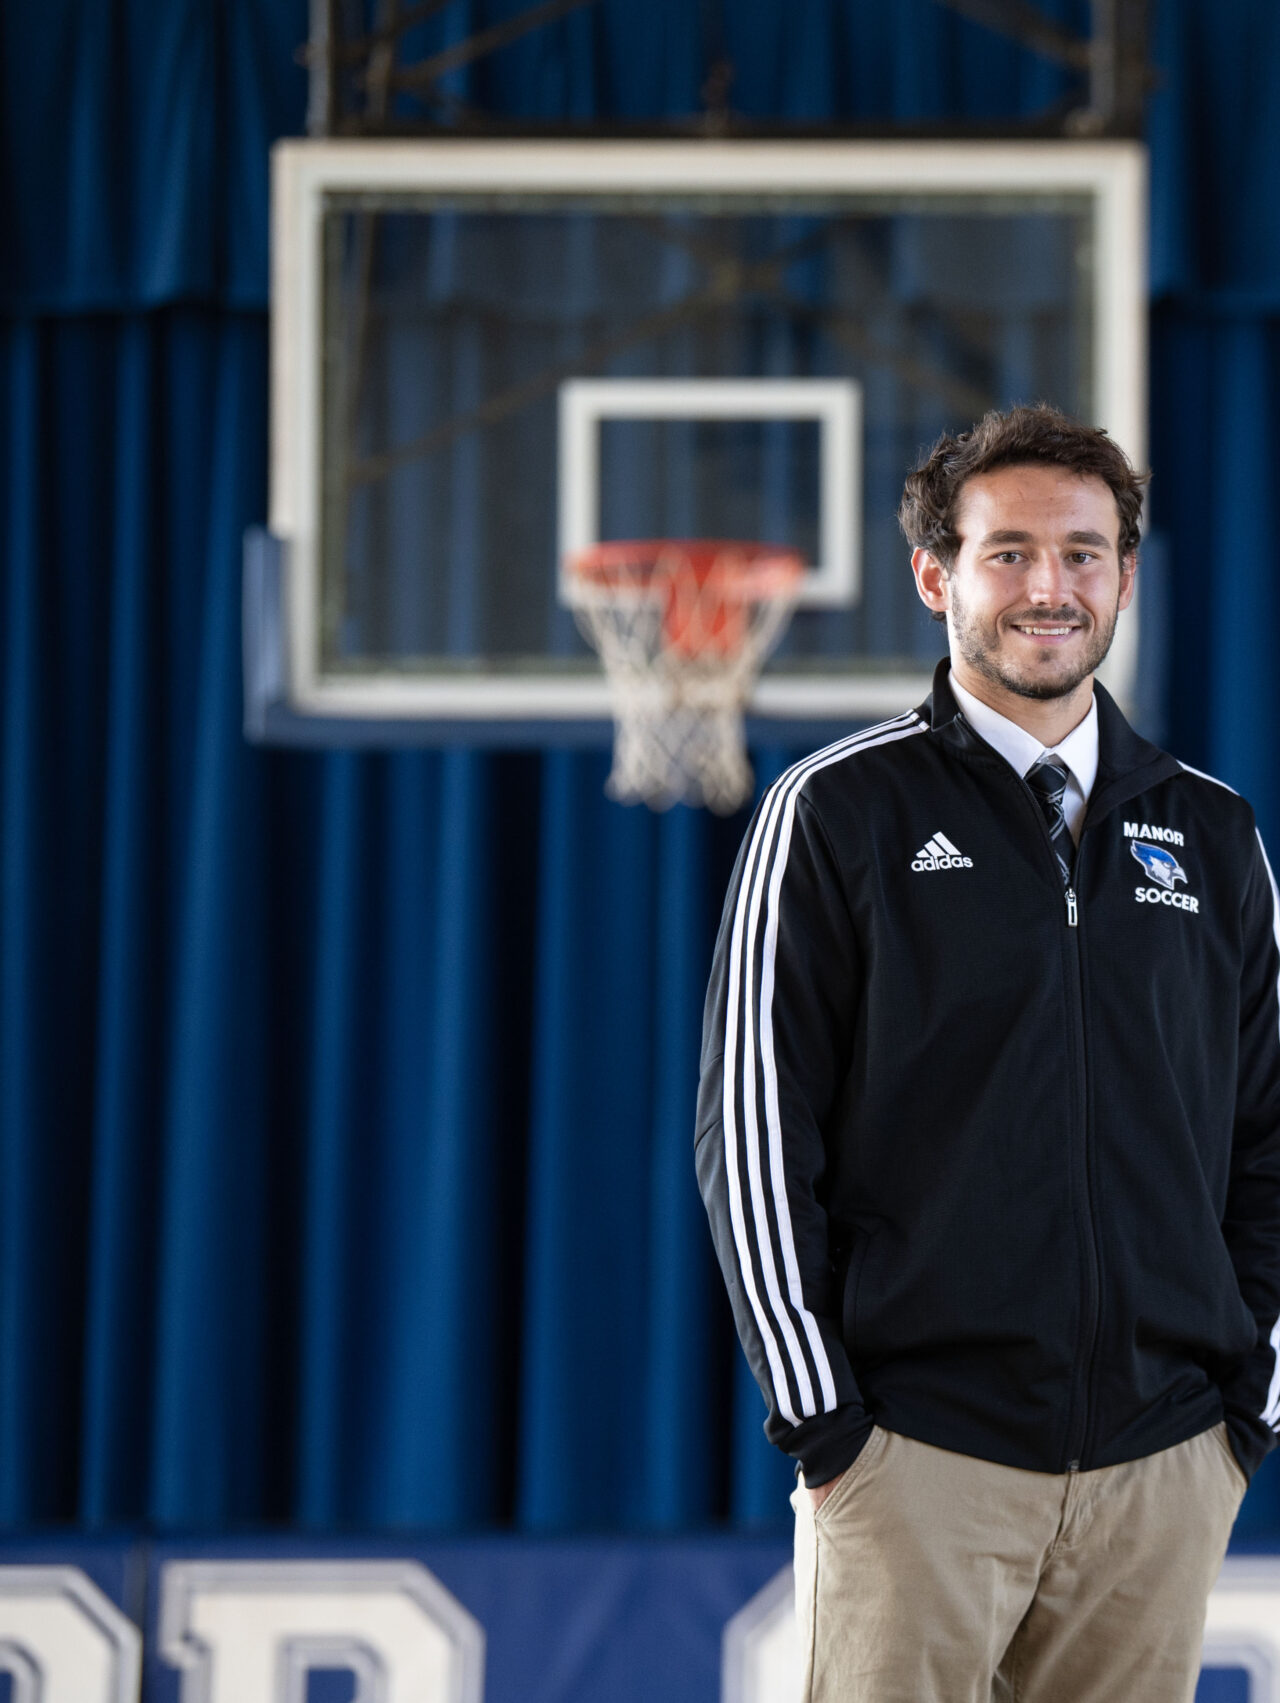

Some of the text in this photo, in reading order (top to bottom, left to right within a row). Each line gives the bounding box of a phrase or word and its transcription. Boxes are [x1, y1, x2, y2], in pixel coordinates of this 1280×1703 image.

[1123, 821, 1185, 847] MANOR
[910, 855, 974, 872] adidas
[1134, 886, 1200, 914] SOCCER
